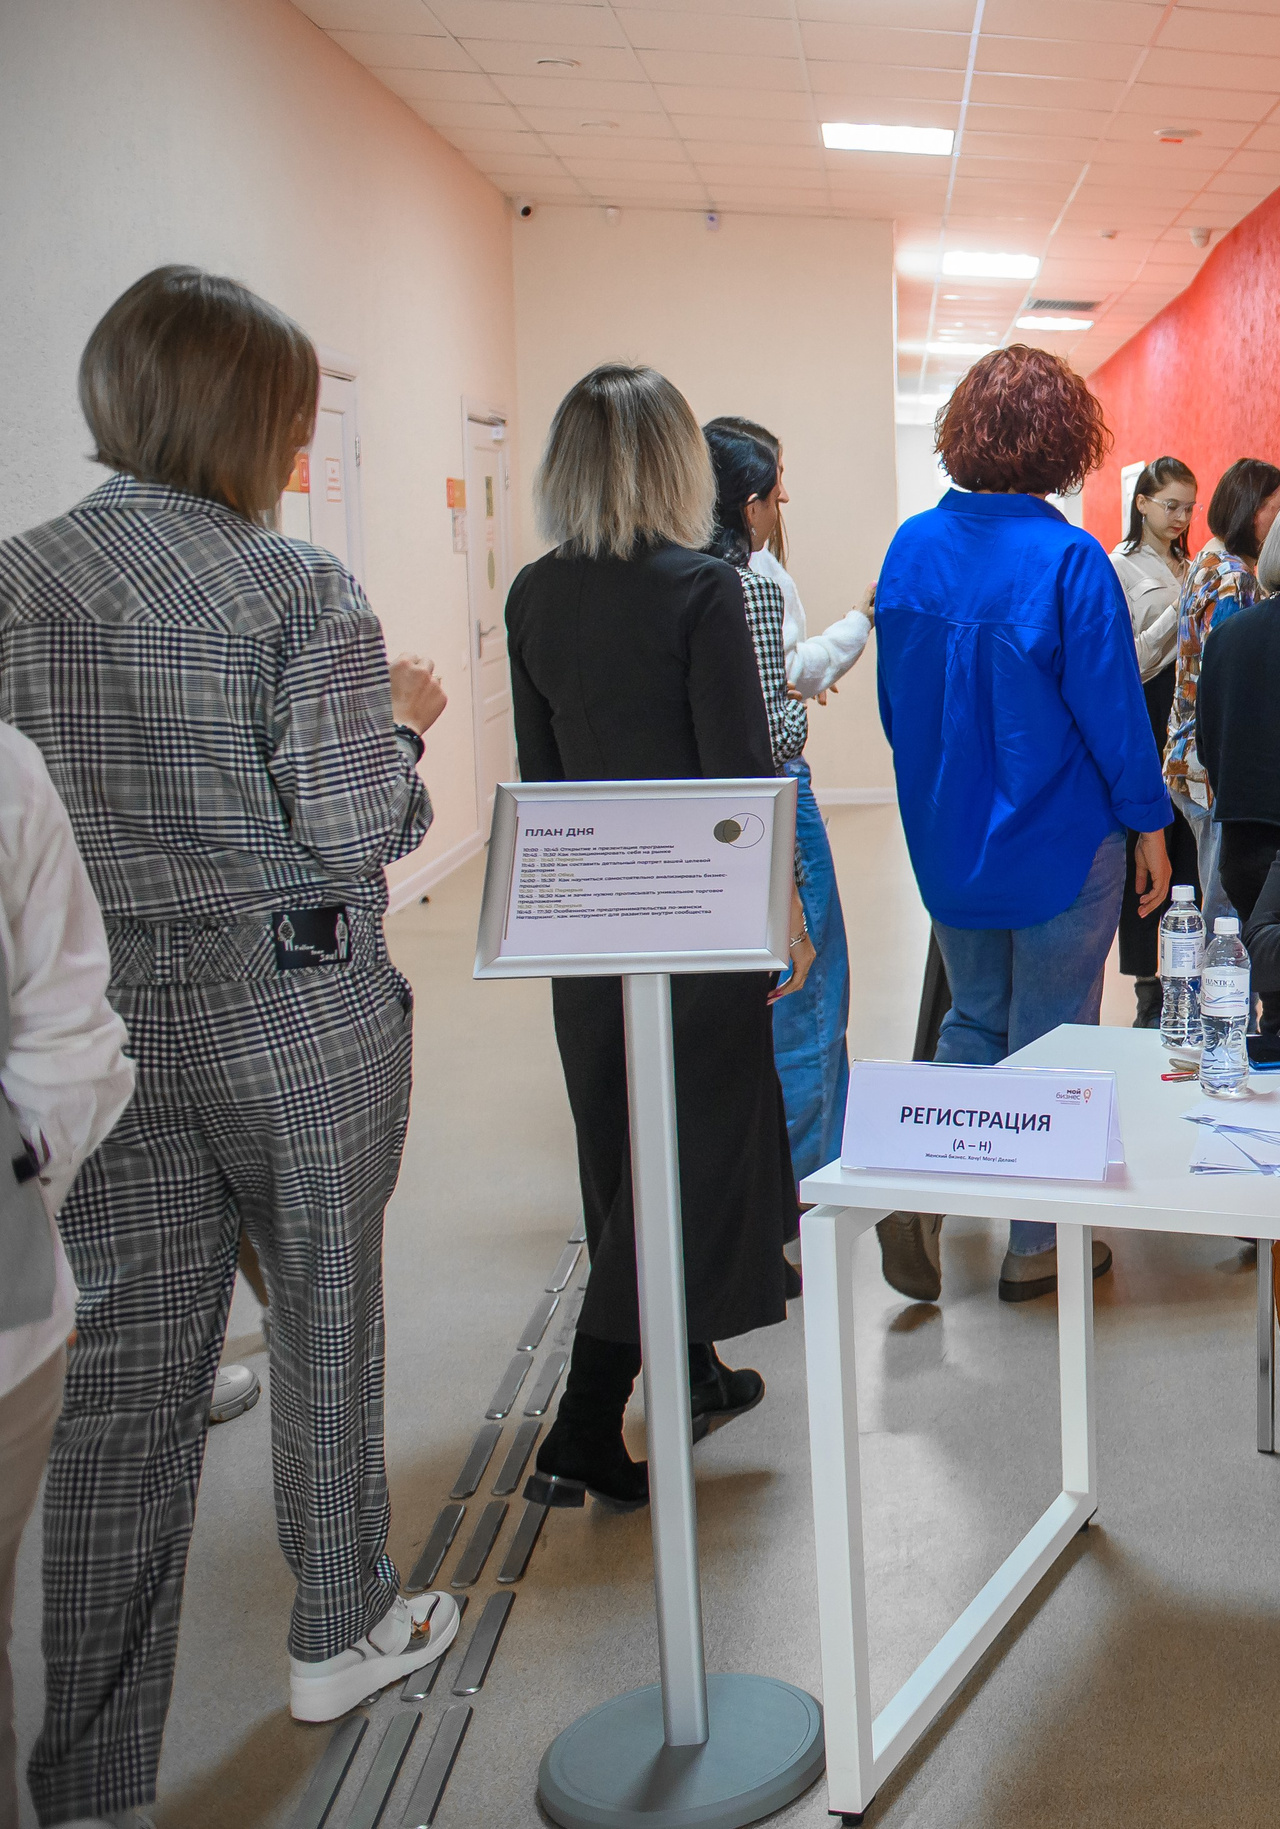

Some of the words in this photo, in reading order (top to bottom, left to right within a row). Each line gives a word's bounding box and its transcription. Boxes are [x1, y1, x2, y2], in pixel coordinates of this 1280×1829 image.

[525, 828, 563, 837] ПЛАН
[566, 827, 594, 837] ДНЯ
[1055, 1092, 1081, 1100] бизнес
[900, 1106, 1051, 1134] РЕГИСТРАЦИЯ
[952, 1139, 965, 1152] (А
[979, 1140, 992, 1154] Н)
